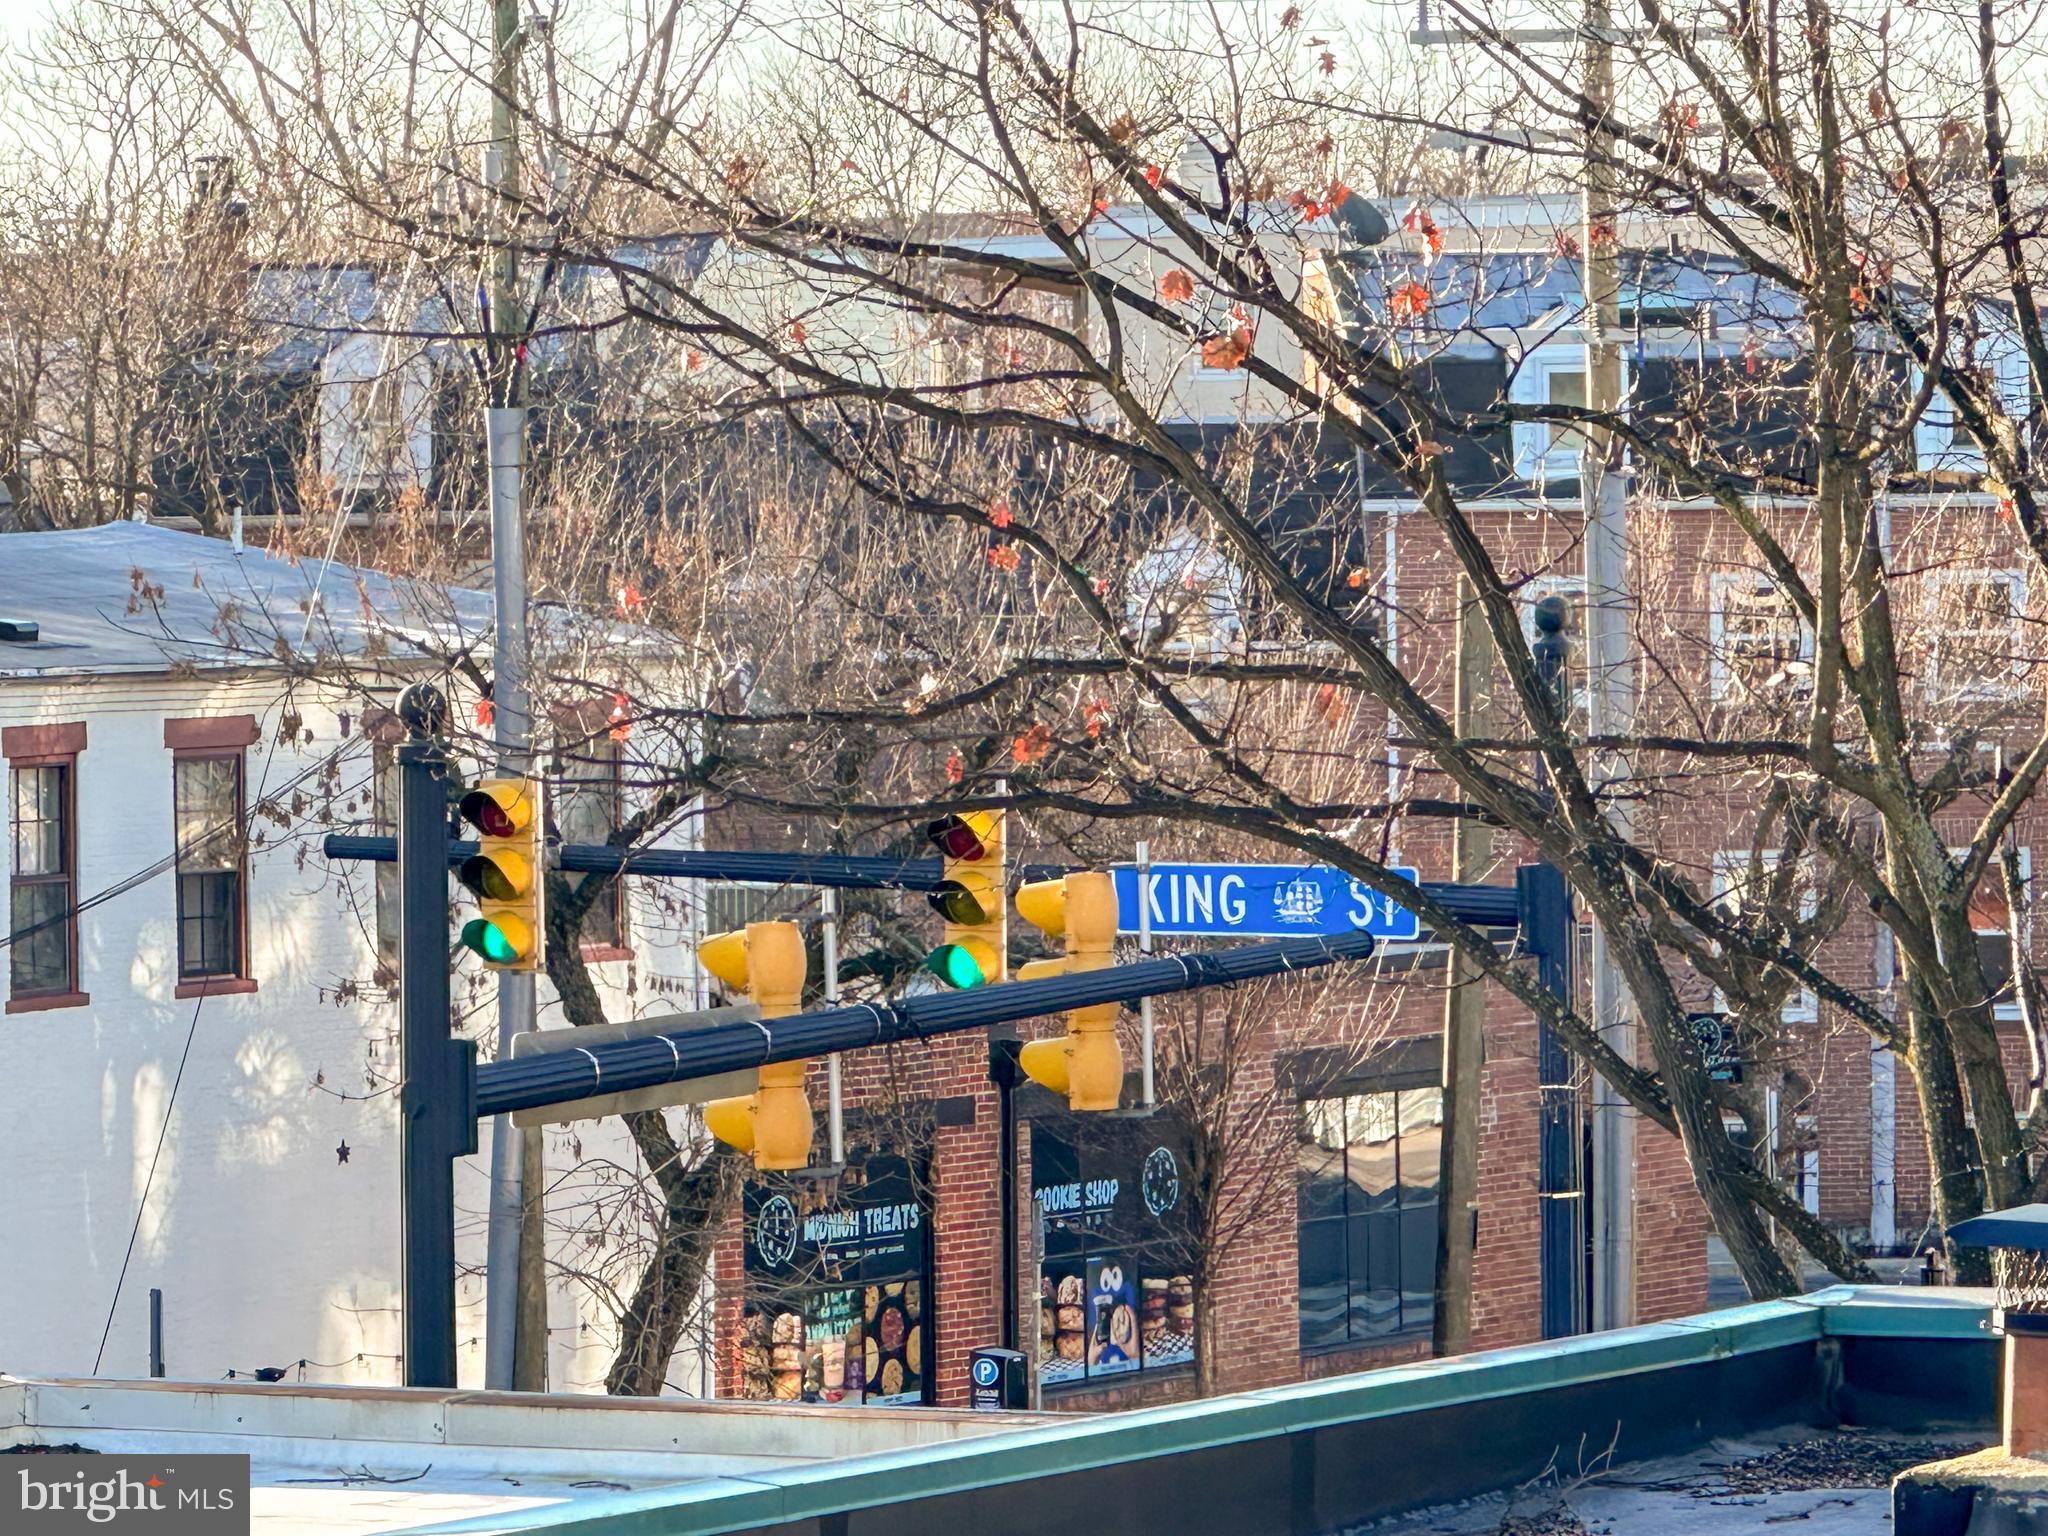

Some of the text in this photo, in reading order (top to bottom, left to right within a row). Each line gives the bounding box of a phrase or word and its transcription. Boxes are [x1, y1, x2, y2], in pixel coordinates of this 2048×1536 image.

[1149, 874, 1246, 925] KING
[1085, 1179, 1119, 1206] SHOP
[803, 1203, 920, 1241] MIDNIGH TREATS
